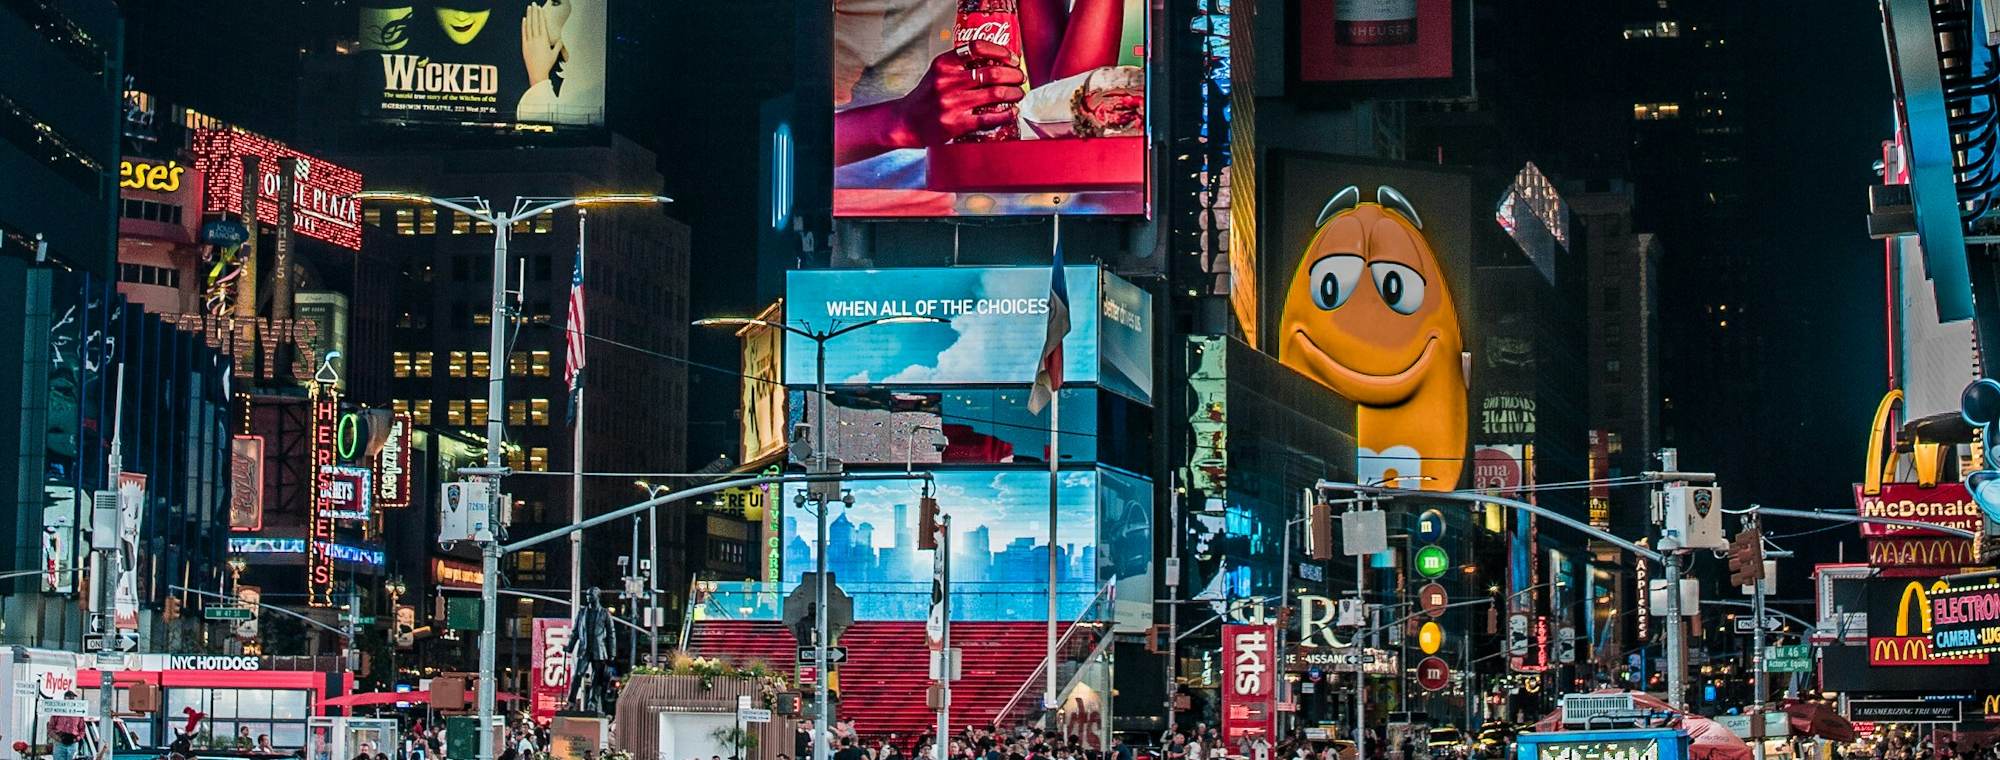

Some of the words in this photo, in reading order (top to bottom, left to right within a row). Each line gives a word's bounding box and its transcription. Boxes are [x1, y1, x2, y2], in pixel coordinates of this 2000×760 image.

[120, 161, 184, 191] ese's
[313, 187, 356, 223] PLAZA
[826, 300, 876, 317] WHEN
[880, 300, 912, 316] ALL
[916, 299, 937, 316] OF
[940, 299, 973, 315] THE
[976, 298, 1049, 315] CHOICES
[1477, 465, 1508, 476] nna
[314, 402, 332, 584] HERSHEY'S
[1865, 499, 1978, 517] McDonald
[1424, 557, 1440, 569] m
[1431, 593, 1443, 605] m
[1297, 594, 1352, 648] R
[1936, 629, 1977, 648] CAMERA
[1776, 647, 1784, 657] W
[1788, 646, 1799, 657] 46
[171, 656, 197, 670] NYC
[1235, 631, 1267, 696] tkts
[1790, 661, 1809, 669] Equity
[45, 671, 73, 694] Ryder
[1427, 668, 1441, 680] m
